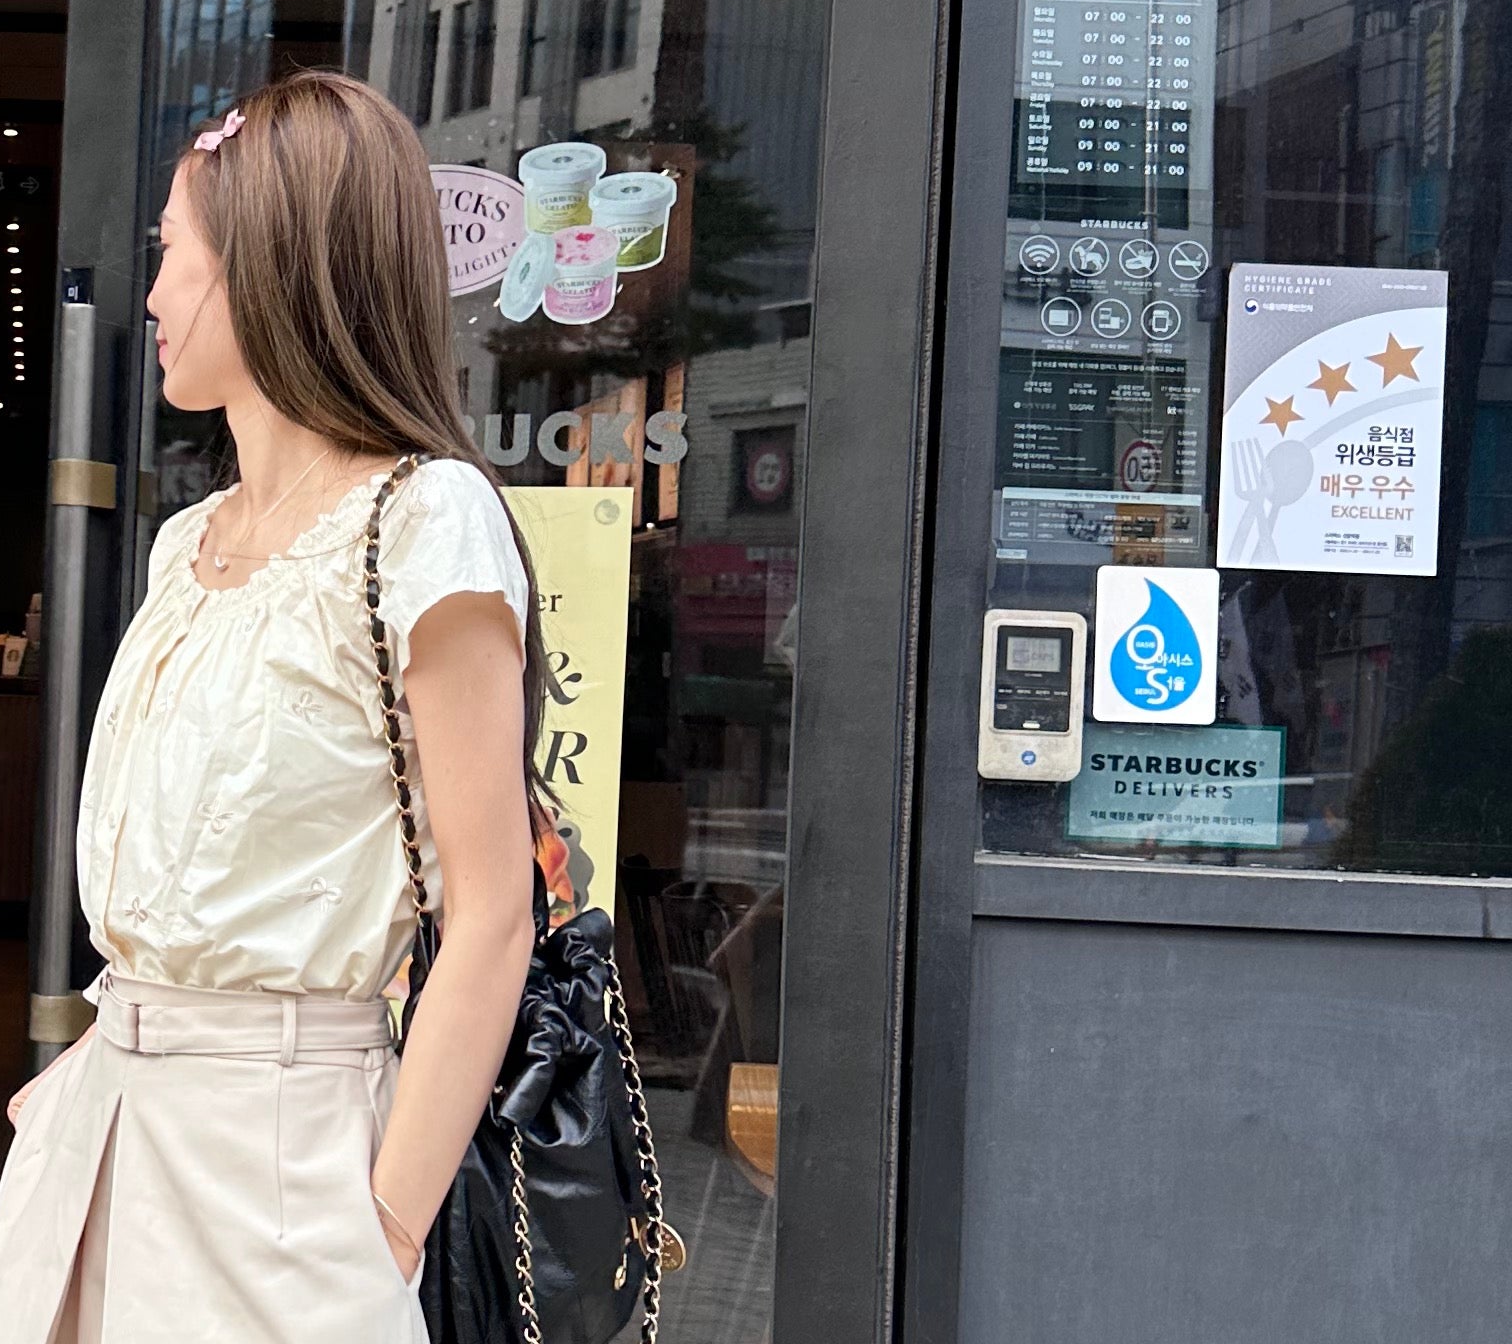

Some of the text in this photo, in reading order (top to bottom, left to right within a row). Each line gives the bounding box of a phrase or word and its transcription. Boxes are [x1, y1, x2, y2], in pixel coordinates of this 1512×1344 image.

[436, 188, 510, 223] UCKS
[444, 222, 486, 245] TO
[1080, 219, 1149, 231] STARBUCKS
[1244, 275, 1333, 287] HYGIENE GRADE
[1244, 284, 1316, 295] CERTIFICATE
[463, 410, 688, 467] UCKS
[1368, 425, 1414, 444] 음식점
[1335, 443, 1416, 467] 위생등급
[1320, 473, 1415, 500] 매우 우수
[1331, 505, 1415, 521] EXCELLENT
[535, 593, 563, 613] er
[1090, 753, 1258, 778] STARBUCKS
[1114, 780, 1233, 800] DELIVERS
[1090, 810, 1106, 821] 저희
[1109, 810, 1135, 821] 매장은
[1137, 812, 1154, 822] 배달
[1157, 813, 1182, 823] 주문이
[1185, 814, 1210, 824] 가능한
